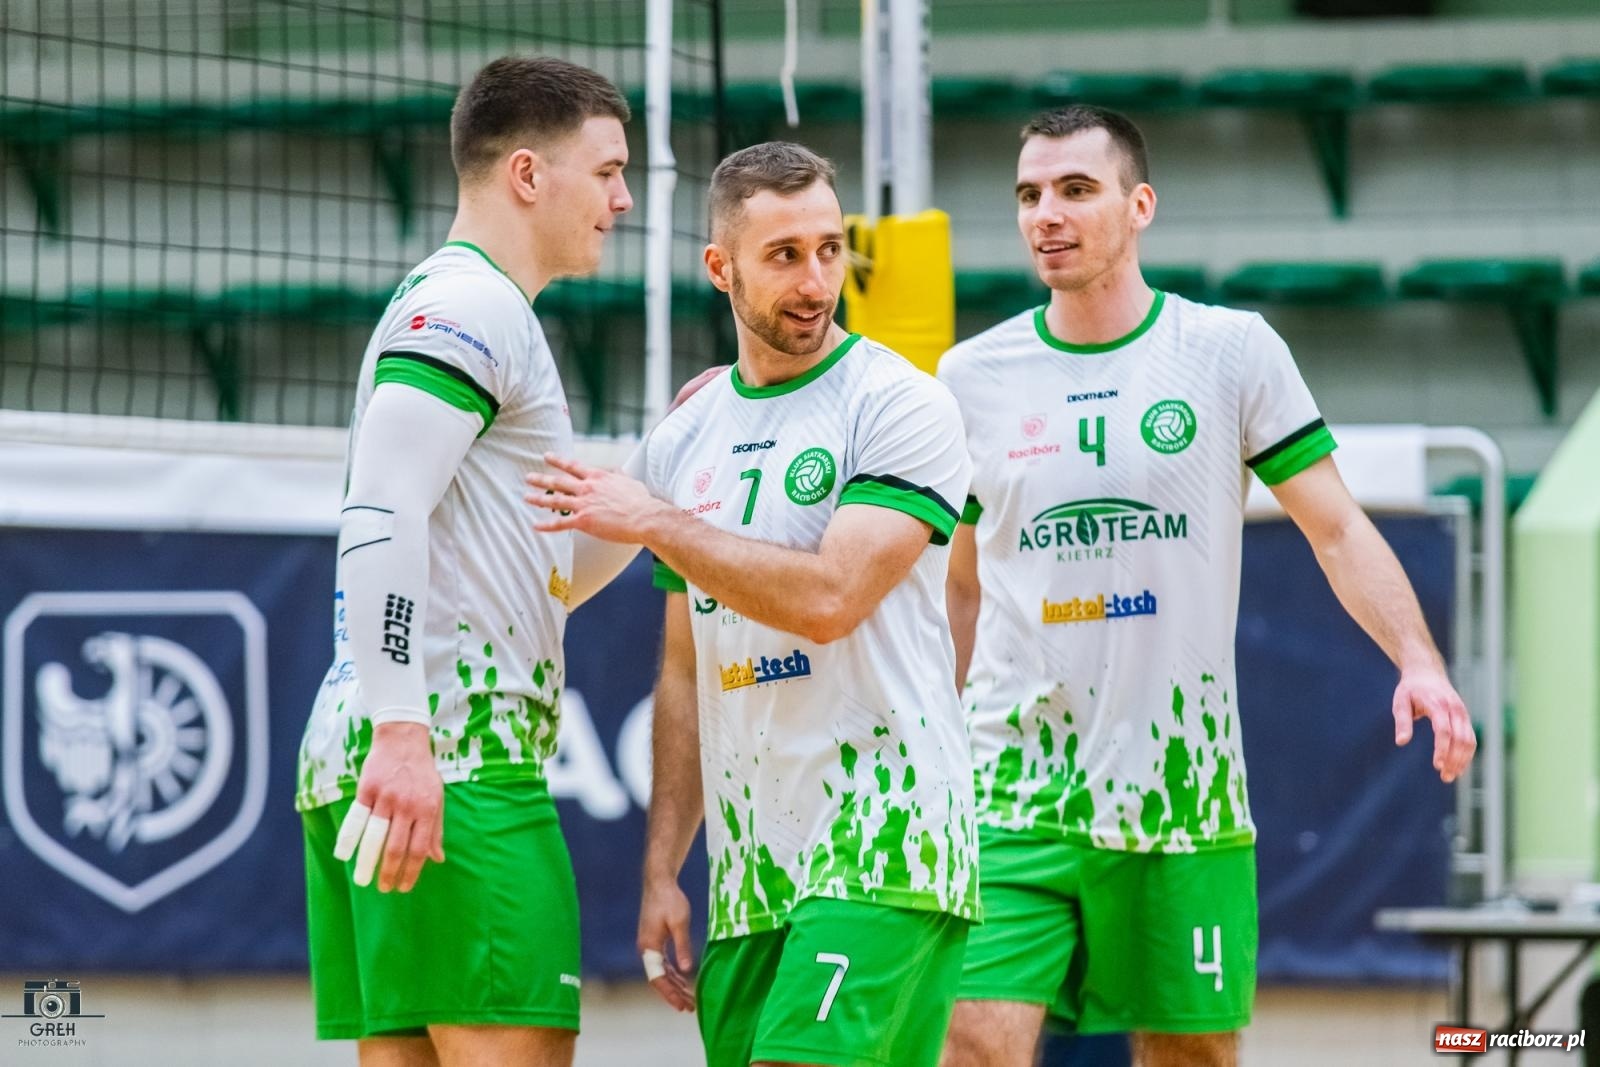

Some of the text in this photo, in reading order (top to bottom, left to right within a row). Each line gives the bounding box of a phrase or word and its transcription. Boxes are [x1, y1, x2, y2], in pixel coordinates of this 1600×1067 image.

[1066, 389, 1118, 403] DECATHLON
[732, 439, 778, 454] DECATHLON
[1079, 416, 1105, 467] 4
[740, 468, 763, 526] 7
[1056, 547, 1115, 563] KIETRZ
[1193, 925, 1223, 992] 4
[815, 952, 850, 1022] 7
